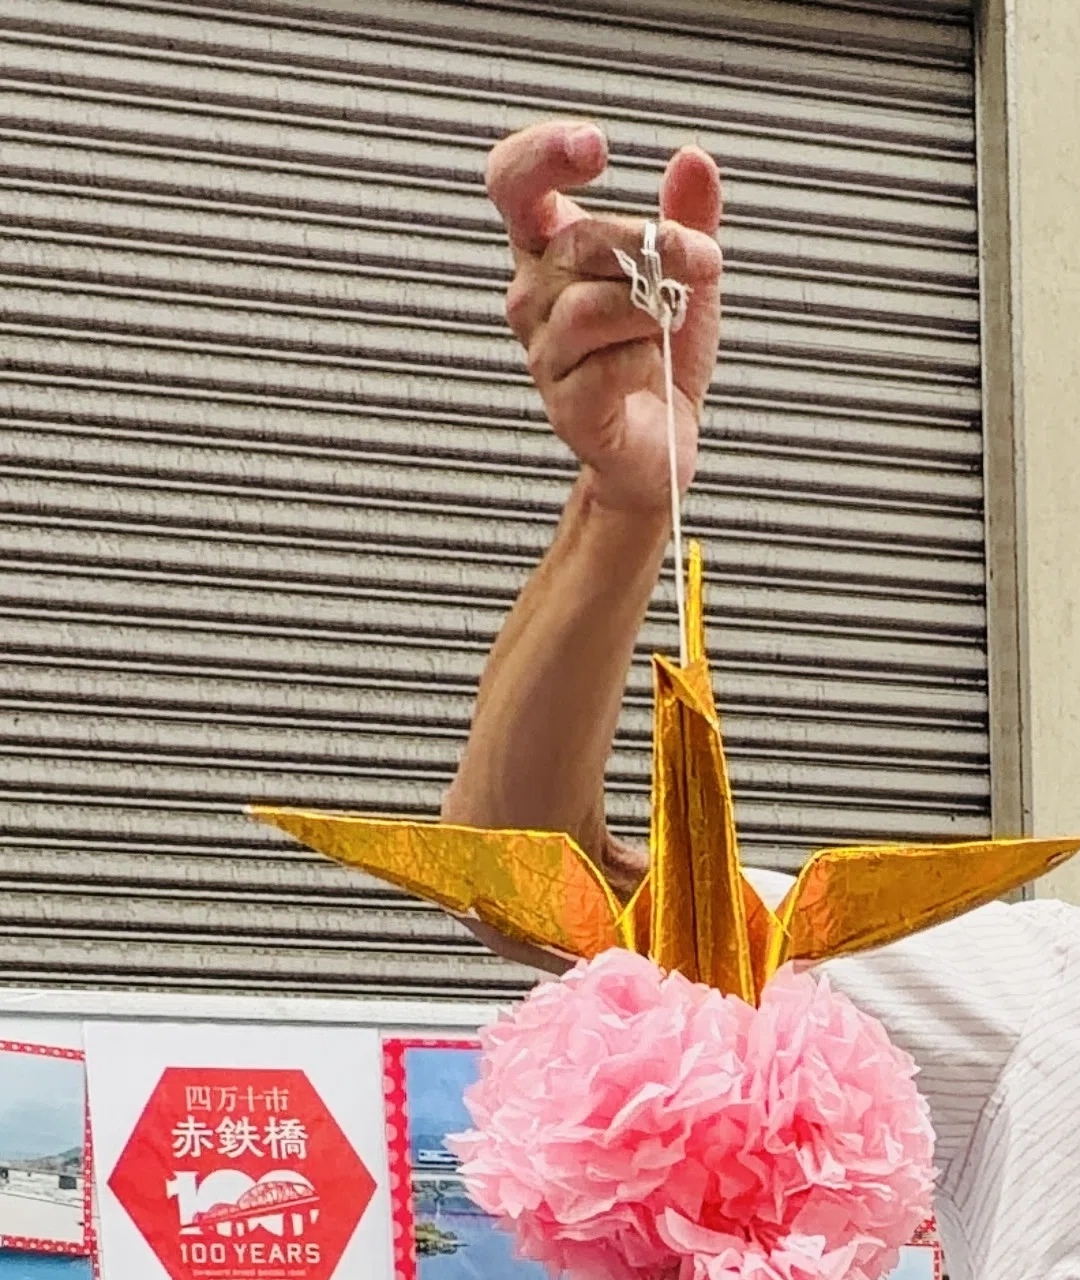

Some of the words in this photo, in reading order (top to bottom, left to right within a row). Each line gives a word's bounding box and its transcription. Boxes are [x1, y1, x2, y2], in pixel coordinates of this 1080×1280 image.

[185, 1086, 289, 1112] 四万十市
[171, 1116, 309, 1159] 赤鉄橋
[180, 1243, 226, 1264] 100
[233, 1243, 321, 1264] YEARS
